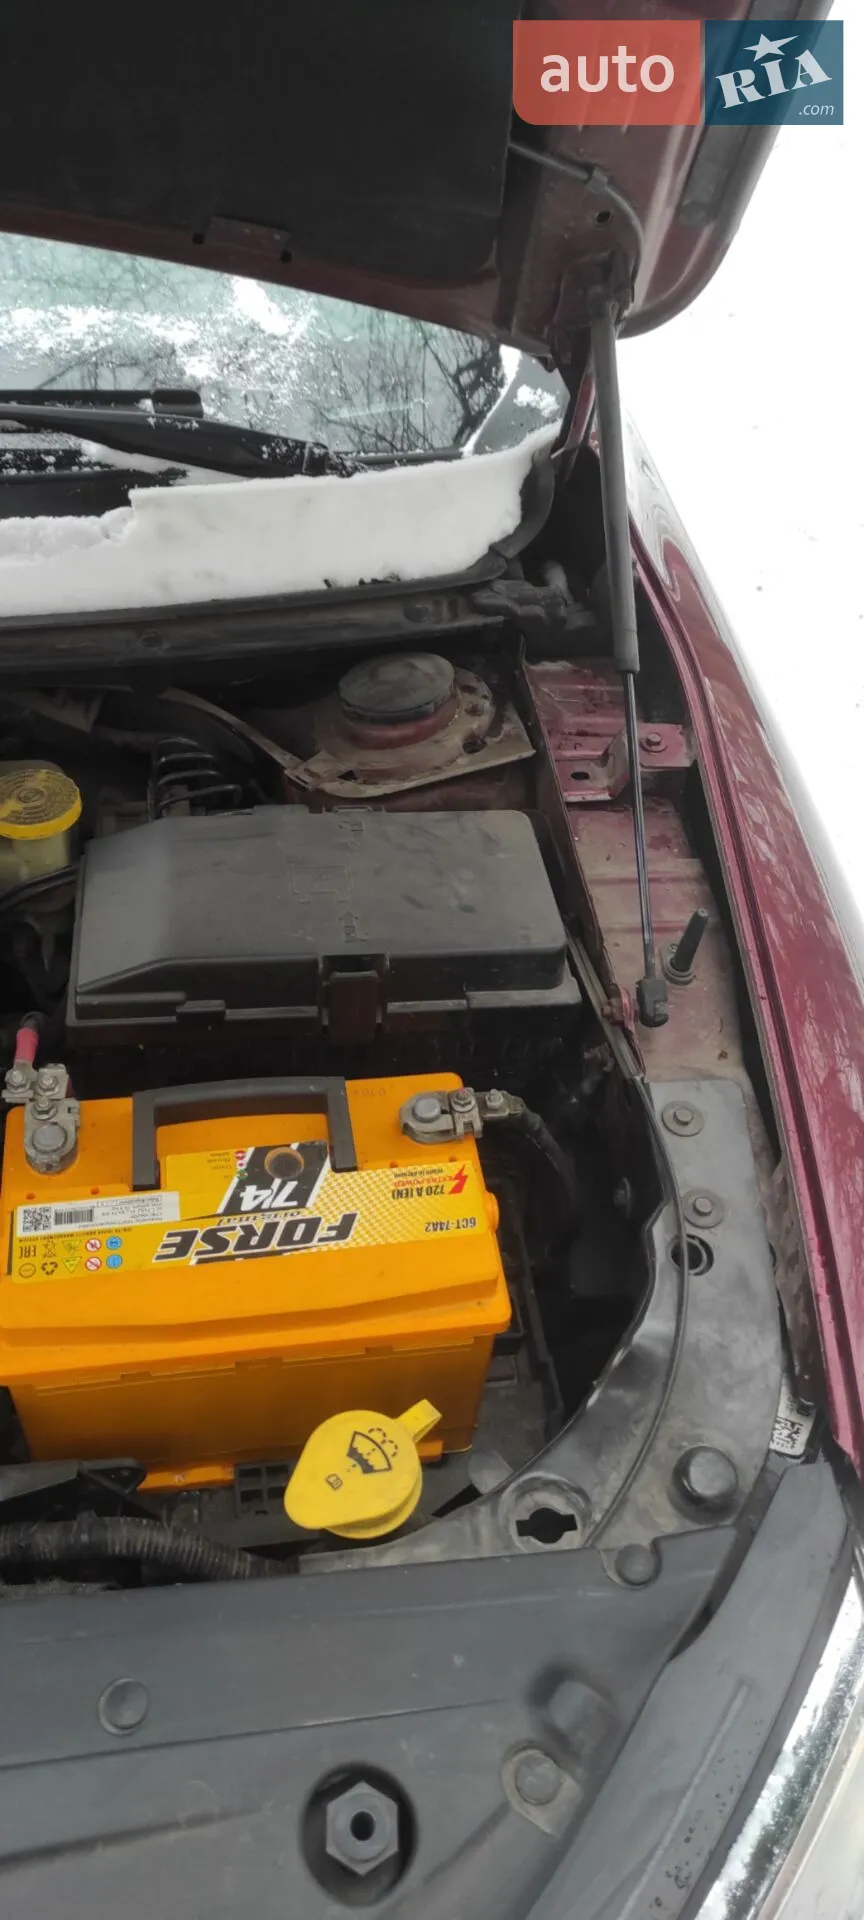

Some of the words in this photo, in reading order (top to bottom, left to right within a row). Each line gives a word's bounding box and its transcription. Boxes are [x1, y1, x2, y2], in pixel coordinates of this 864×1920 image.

[240, 1183, 299, 1211] 74
[415, 1187, 423, 1197] A
[426, 1185, 445, 1196] 720
[425, 1217, 476, 1233] 6CT-74A2
[154, 1212, 358, 1262] FORSE
